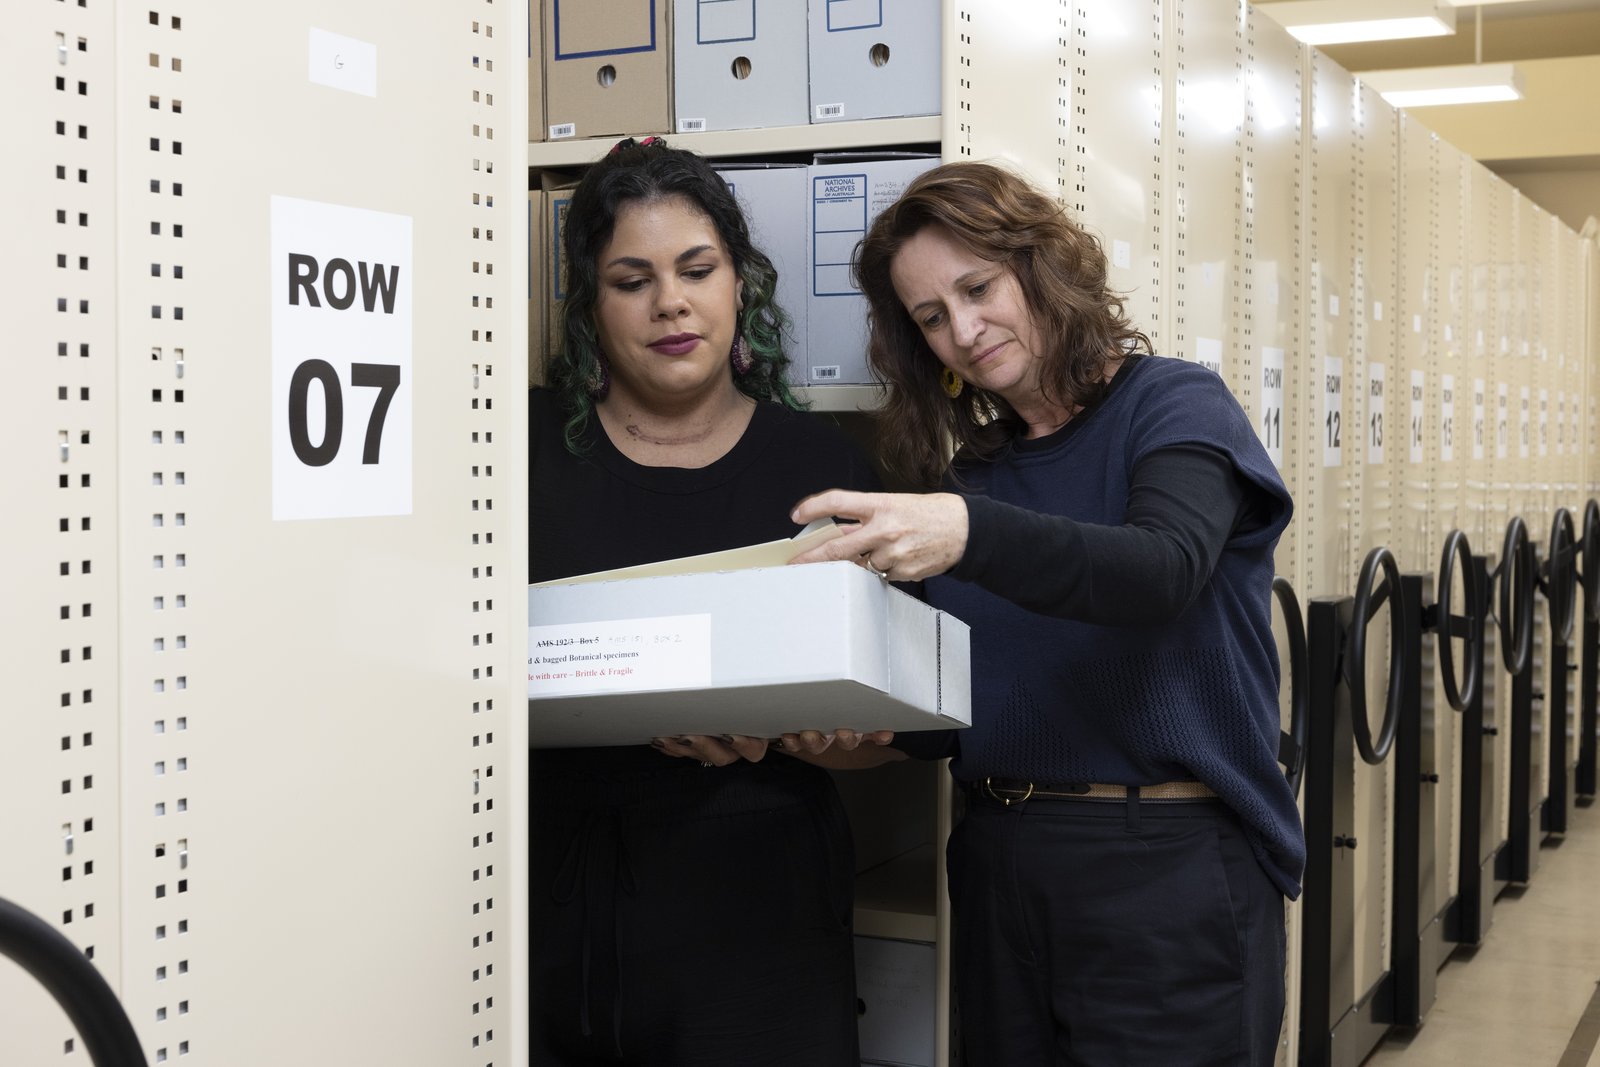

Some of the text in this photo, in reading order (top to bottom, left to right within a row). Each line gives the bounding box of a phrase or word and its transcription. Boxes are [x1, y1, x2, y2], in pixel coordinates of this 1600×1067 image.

[825, 185, 856, 193] ARCHIVES
[288, 252, 400, 315] ROW
[1264, 367, 1282, 389] ROW
[1326, 375, 1342, 393] ROW
[1371, 379, 1383, 396] ROW
[288, 358, 401, 468] 07
[1264, 407, 1280, 449] 11
[1326, 410, 1341, 448] 12
[1371, 412, 1383, 447] 13
[1412, 416, 1422, 447] 14
[1443, 417, 1452, 447] 15
[536, 639, 554, 648] AMS
[555, 637, 574, 647] 192/3
[580, 637, 593, 645] Box
[594, 636, 600, 644] 5
[543, 655, 567, 665] bagged
[569, 653, 602, 662] Botanical
[604, 651, 640, 660] specimens
[536, 672, 551, 680] with
[552, 672, 567, 680] care
[576, 670, 598, 678] Brittle
[608, 667, 634, 676] Fragile
